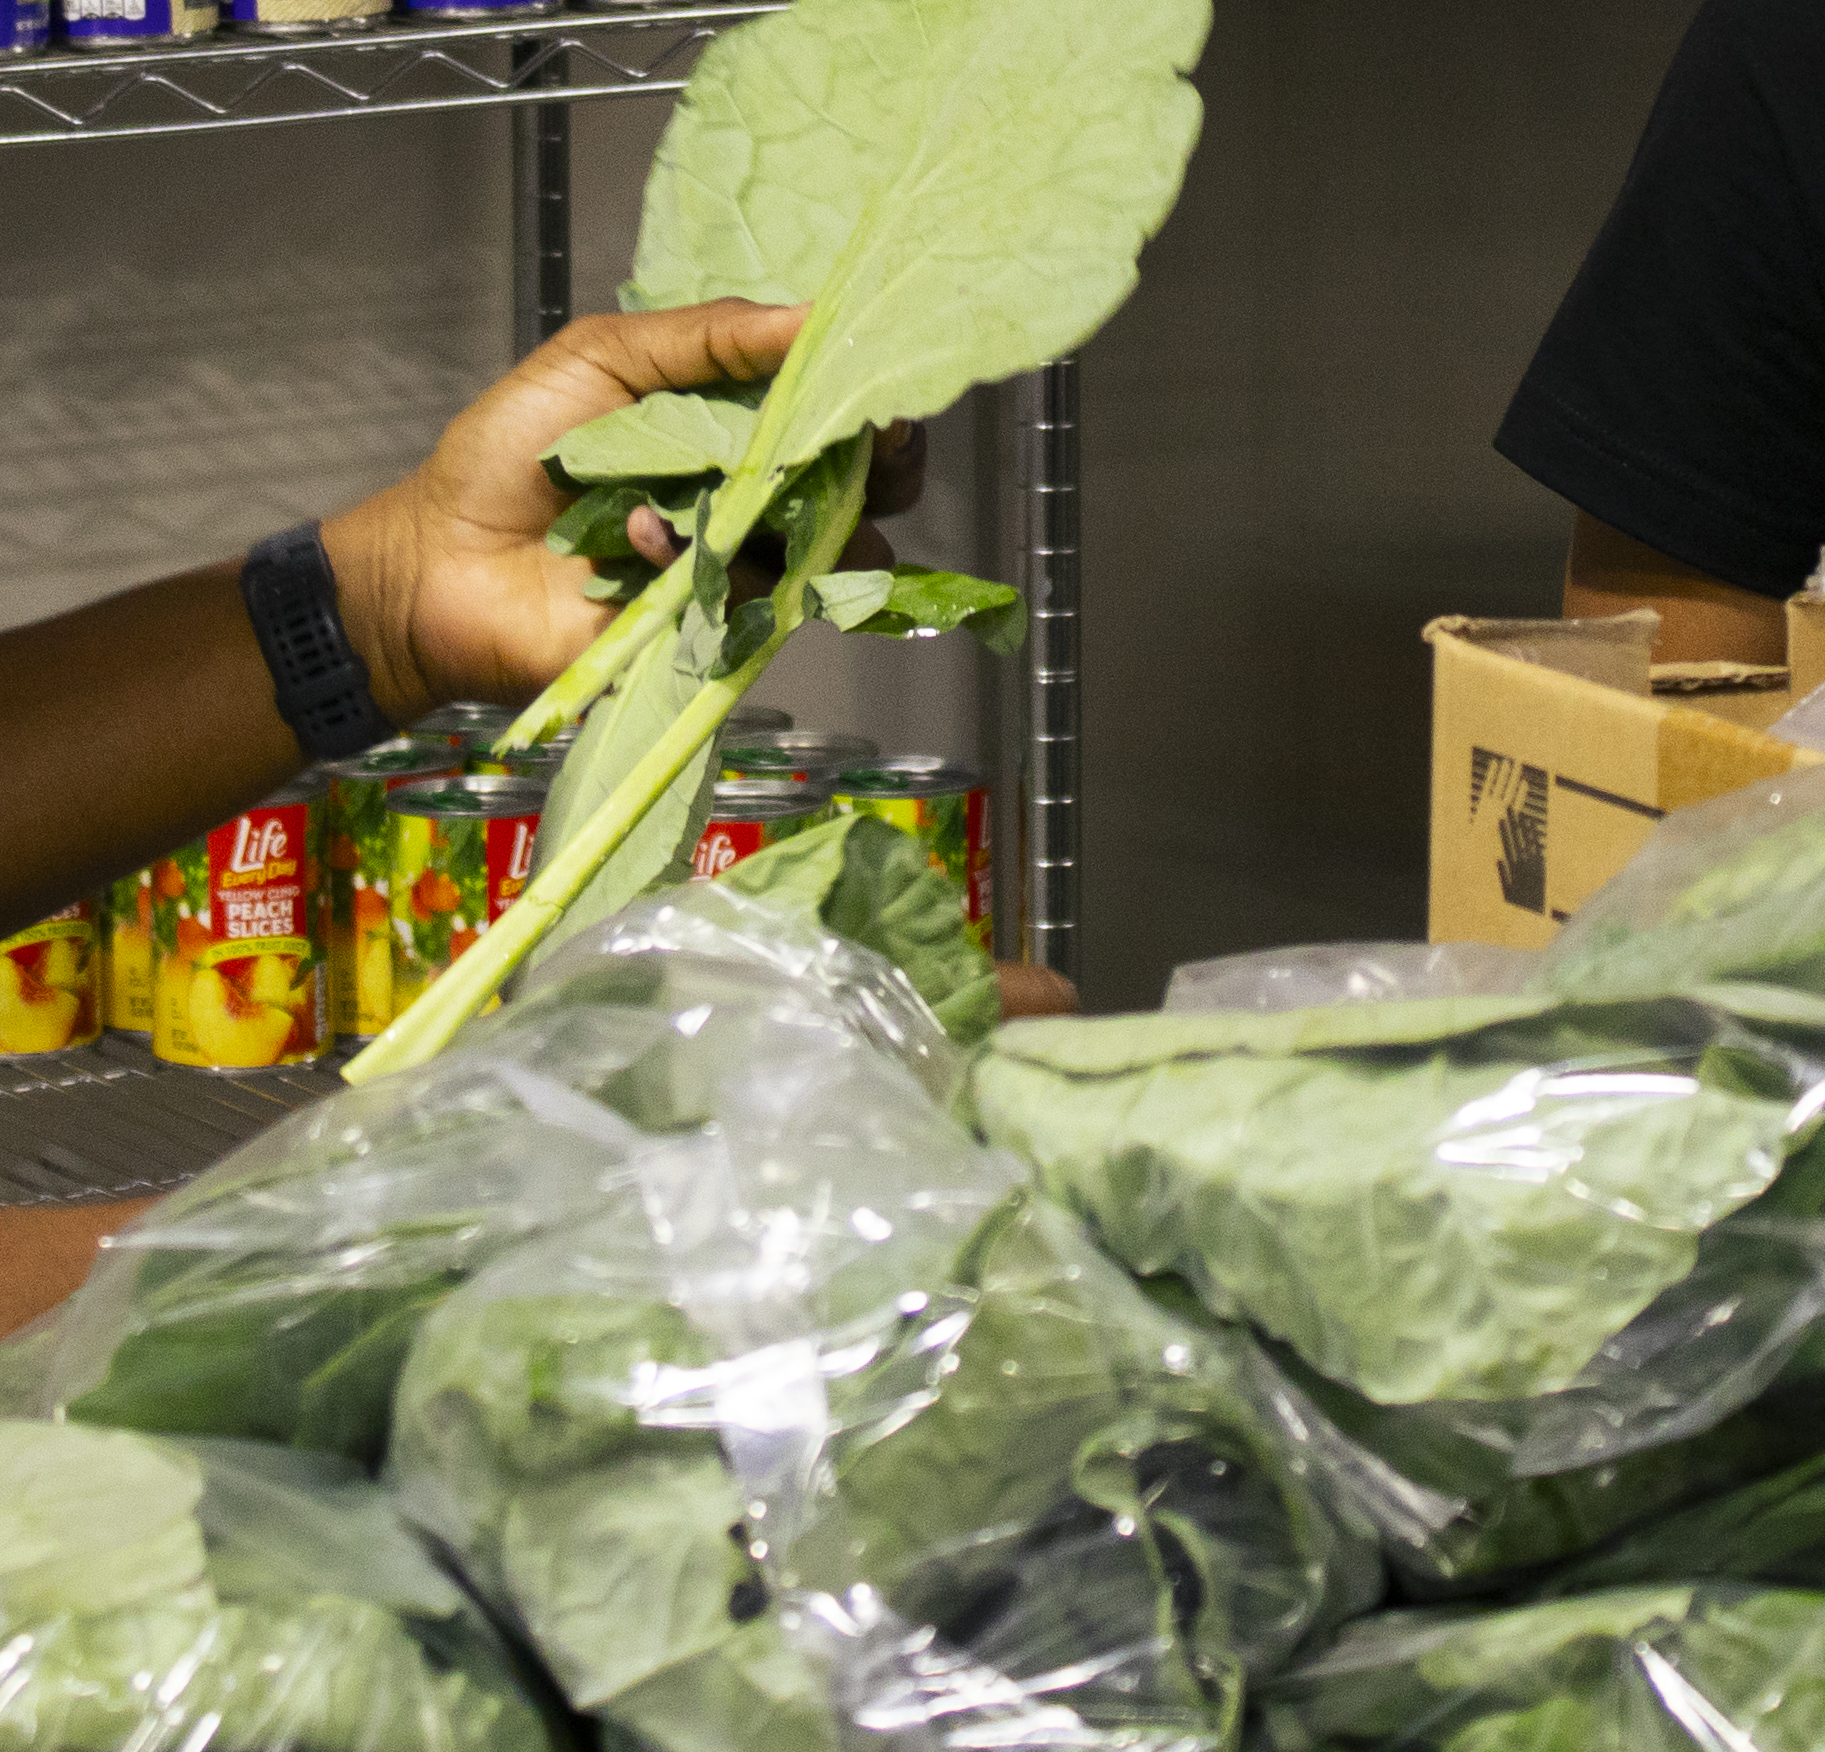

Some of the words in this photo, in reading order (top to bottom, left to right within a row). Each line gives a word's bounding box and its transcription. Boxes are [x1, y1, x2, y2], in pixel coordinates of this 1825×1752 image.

[230, 815, 288, 872] Life
[228, 899, 293, 921] PEACH
[228, 918, 294, 939] SLICES
